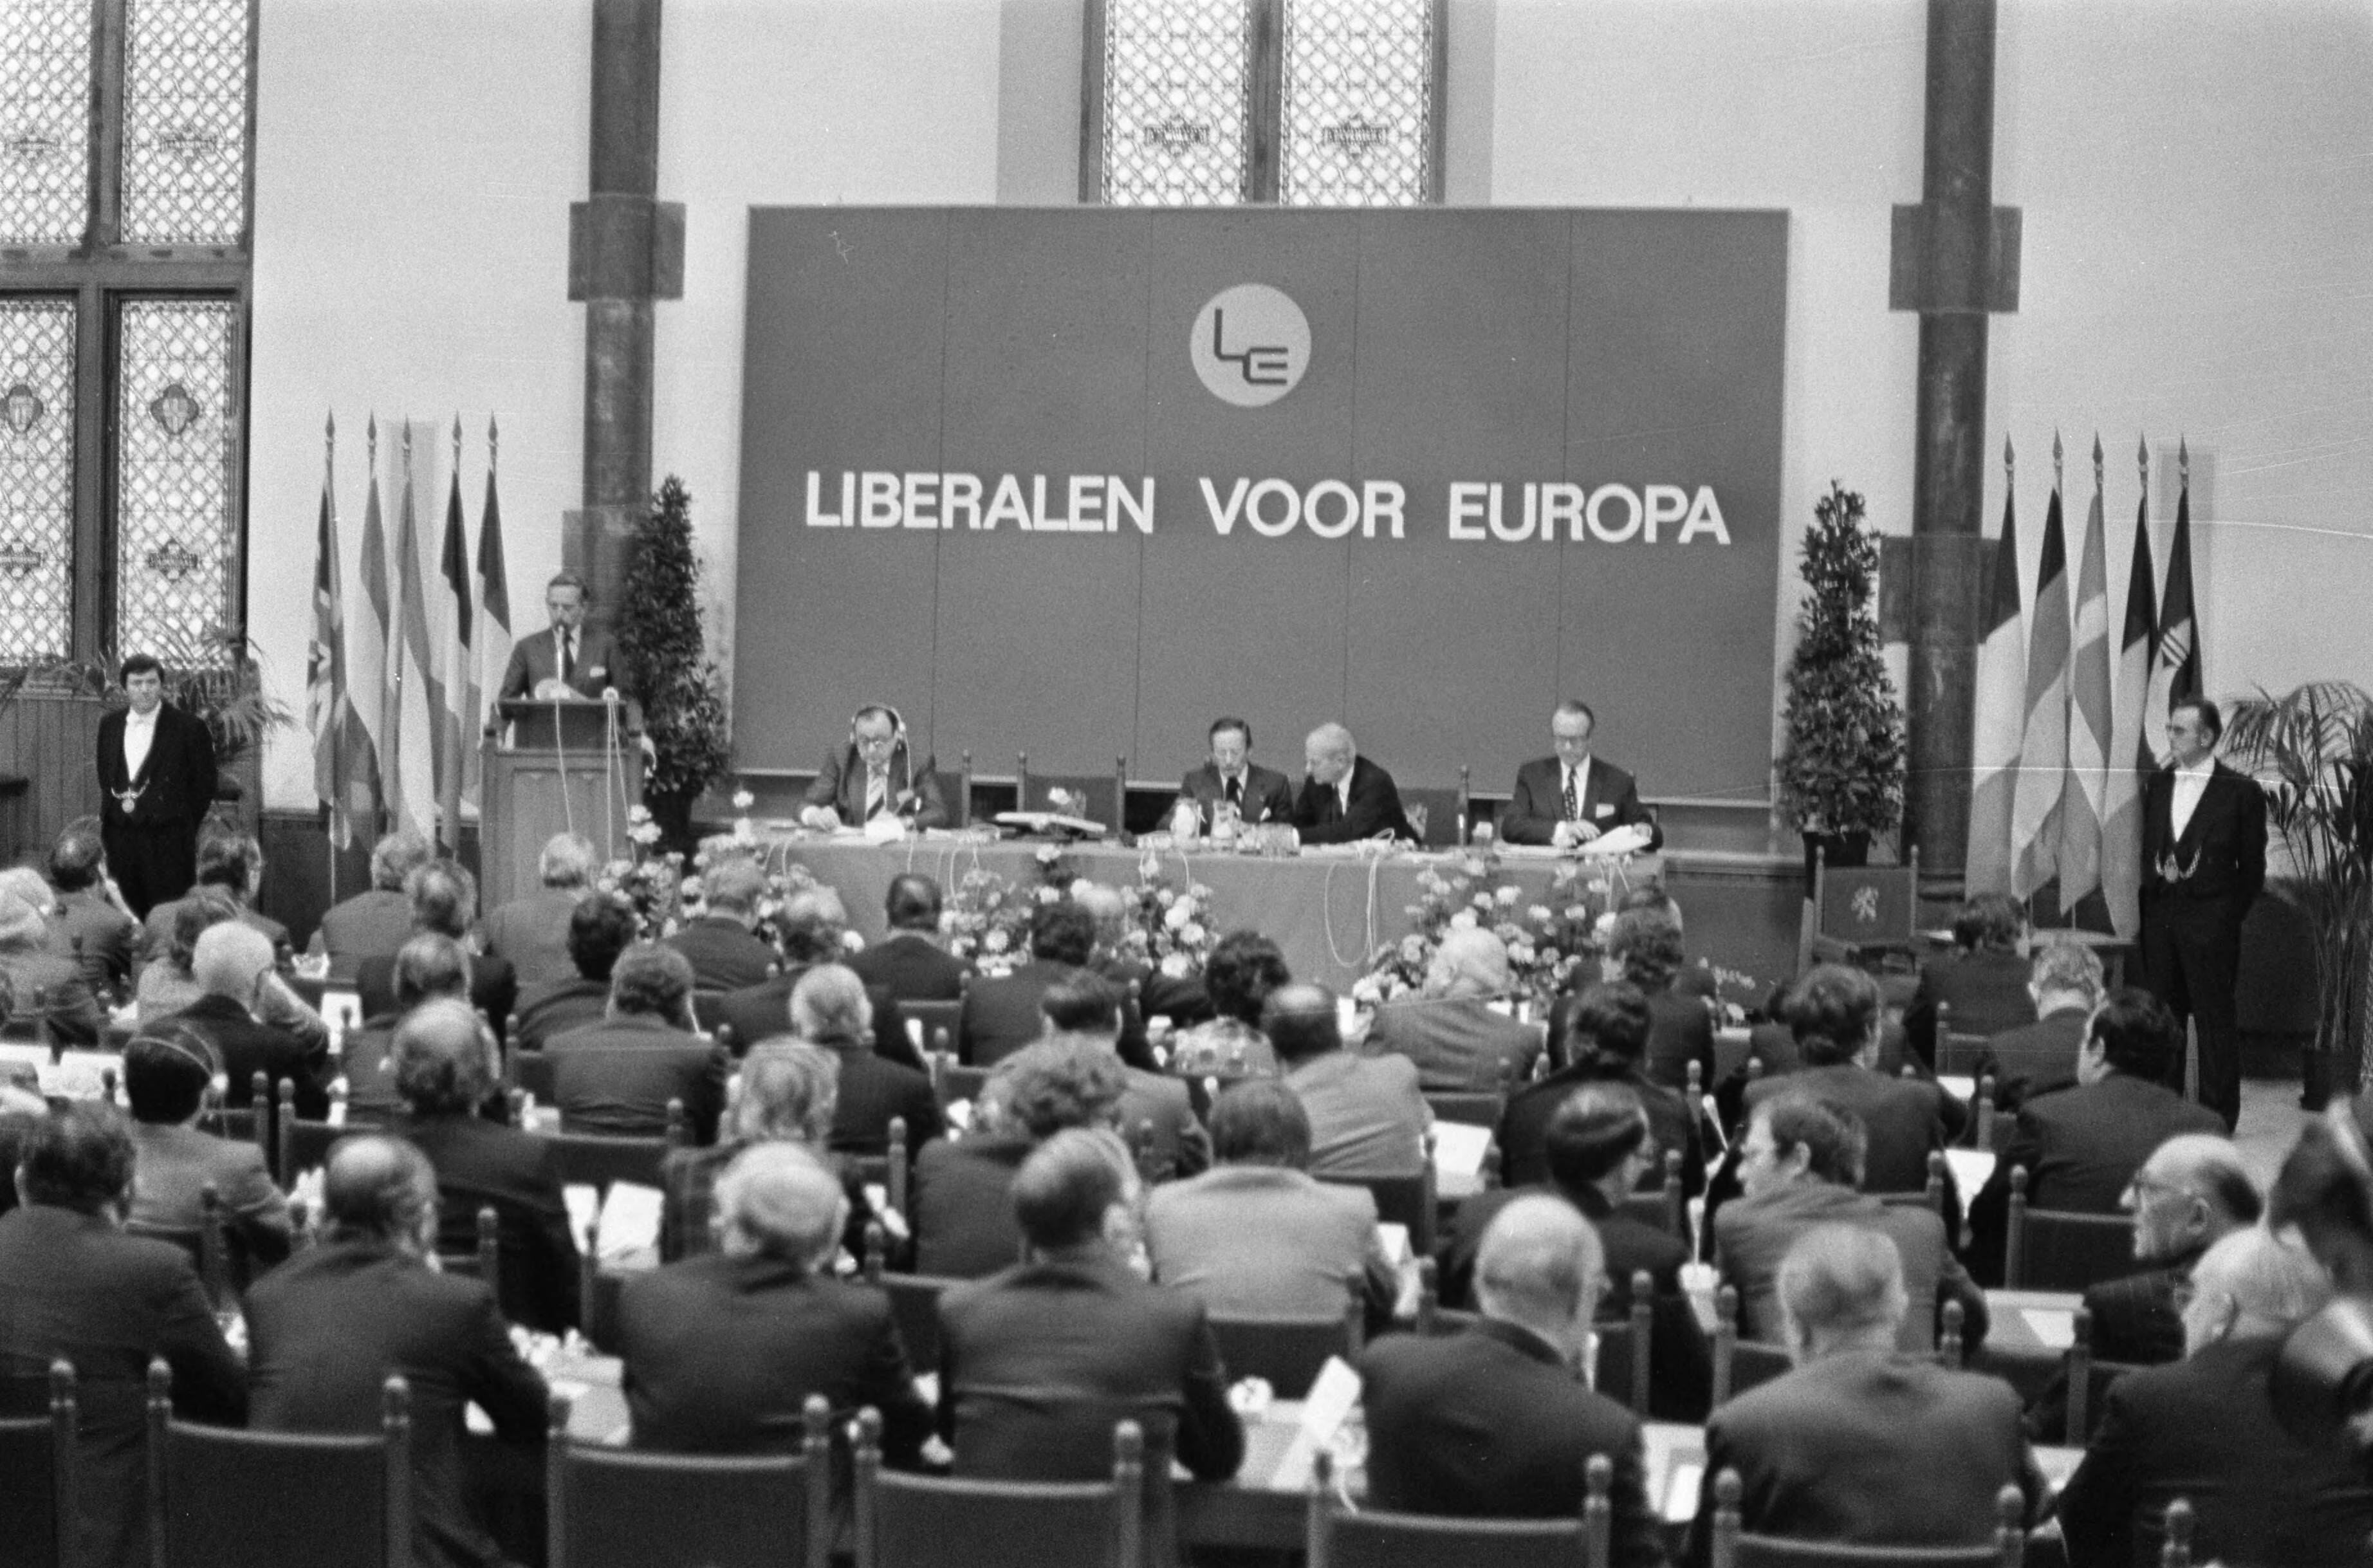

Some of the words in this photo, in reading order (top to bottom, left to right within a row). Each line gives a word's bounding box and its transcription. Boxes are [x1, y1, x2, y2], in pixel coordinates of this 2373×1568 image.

[806, 470, 1155, 535] LIBERALEN
[1198, 477, 1405, 539] VOOR
[1448, 481, 1731, 544] EUROPA
